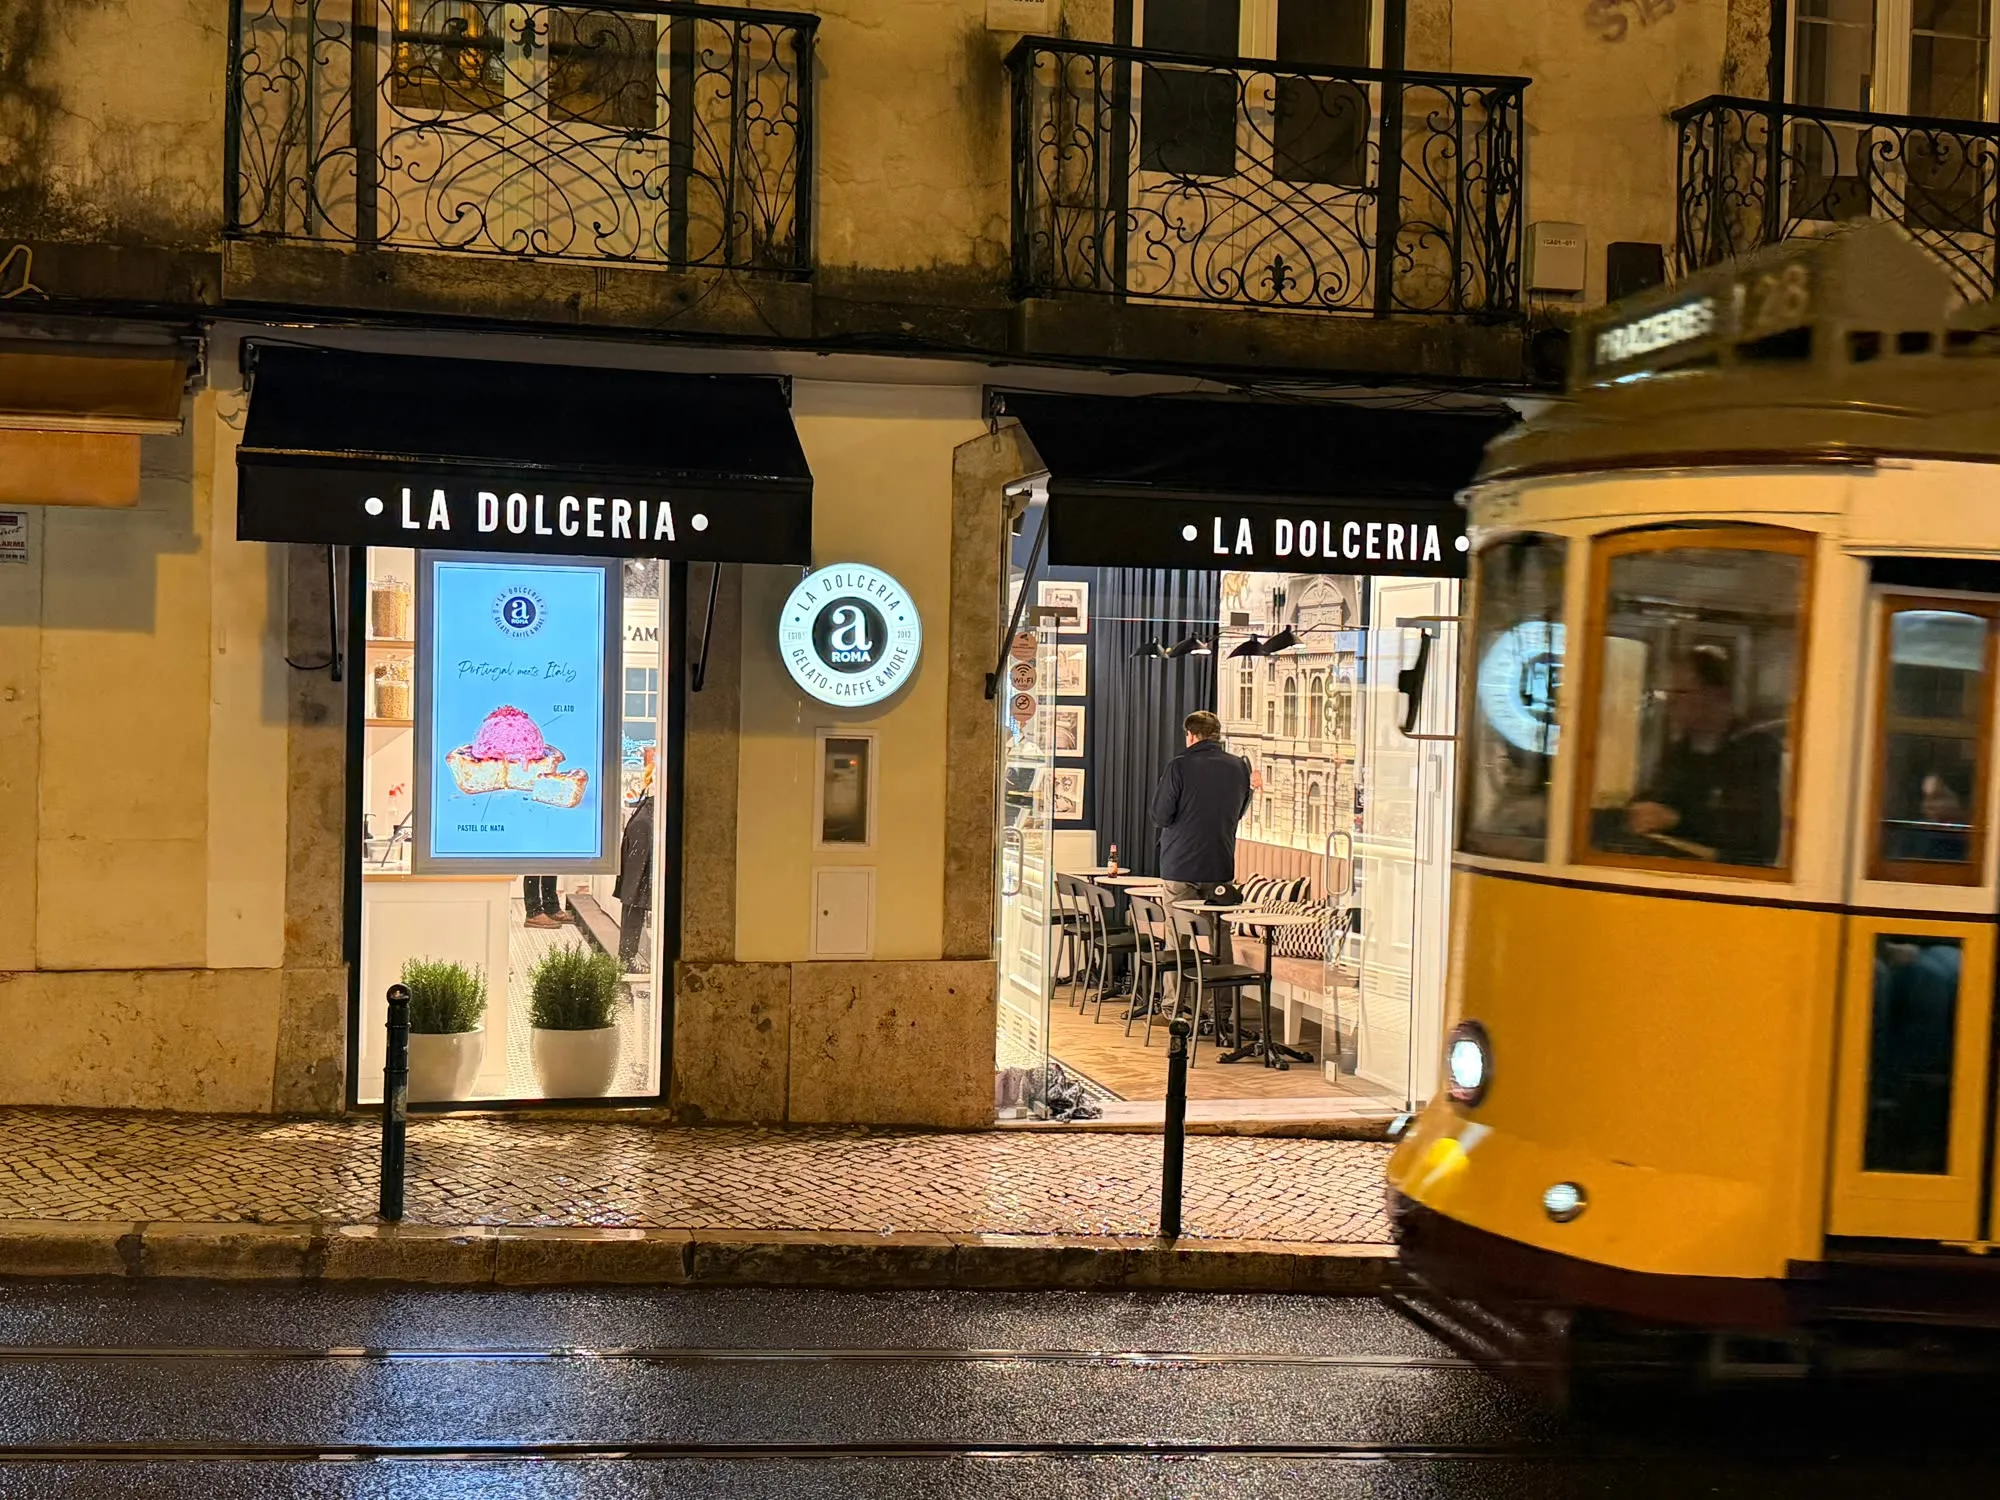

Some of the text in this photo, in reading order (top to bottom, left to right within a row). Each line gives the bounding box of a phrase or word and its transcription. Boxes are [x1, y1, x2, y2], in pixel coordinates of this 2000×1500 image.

[402, 488, 676, 541] LA DOLCERIA
[1213, 516, 1441, 562] LA DOLCERIA
[496, 586, 542, 603] LA DOLCERIA
[797, 573, 901, 612] LA DOLCERIA
[831, 605, 873, 652] a
[458, 660, 515, 681] Portugal
[543, 661, 577, 682] Italy
[792, 648, 828, 689] GELATO
[875, 675, 887, 687] &
[883, 646, 909, 680] MORE
[831, 651, 872, 663] ROMA
[553, 704, 575, 713] GELATO
[457, 824, 505, 832] PASTEL DE NATA
